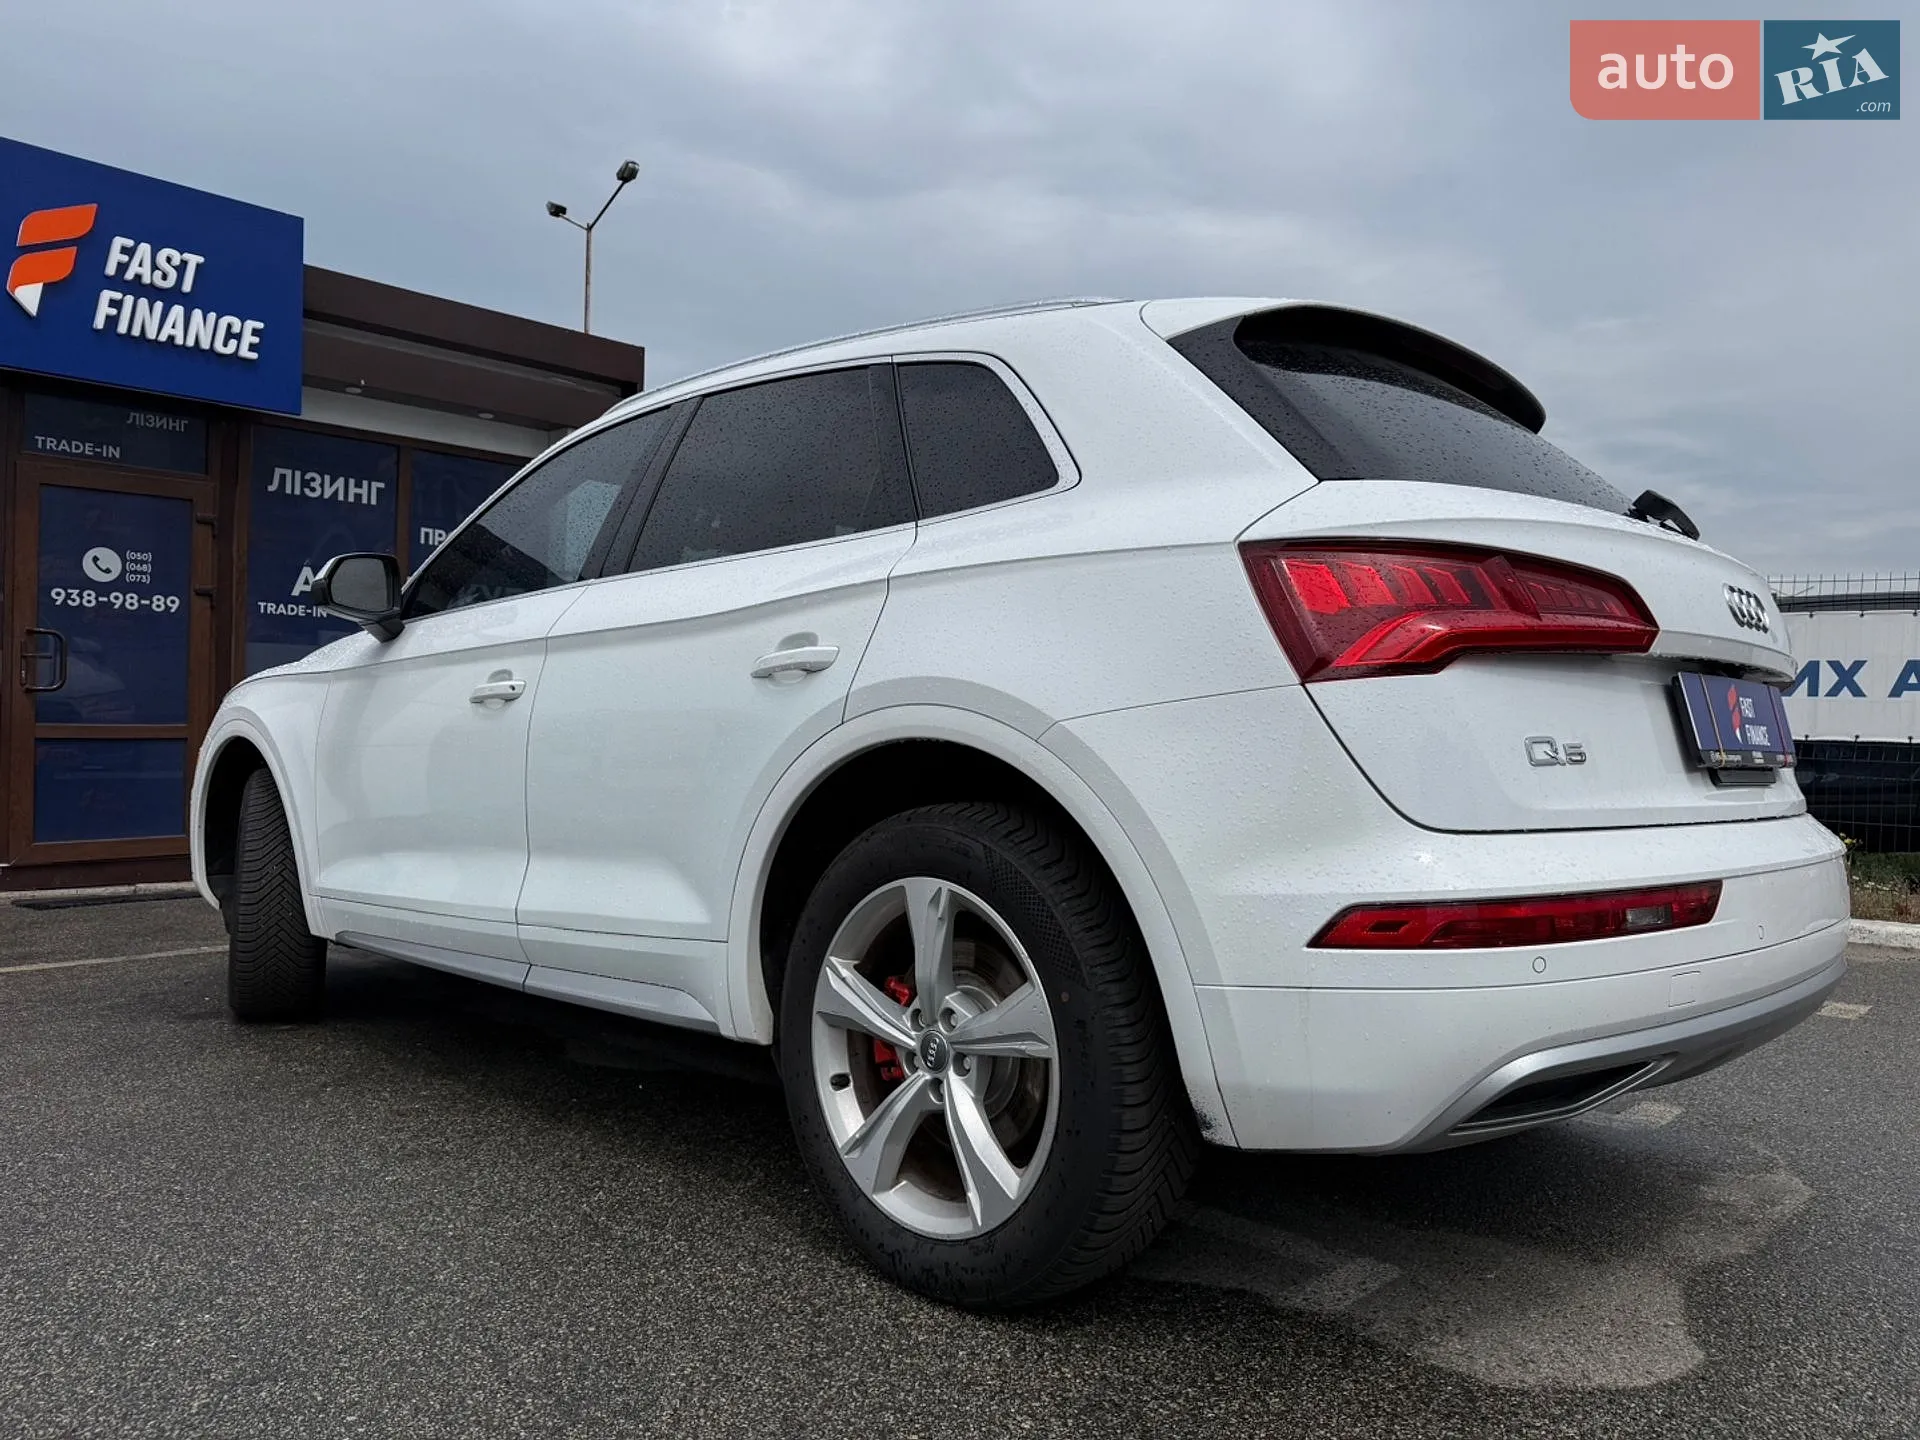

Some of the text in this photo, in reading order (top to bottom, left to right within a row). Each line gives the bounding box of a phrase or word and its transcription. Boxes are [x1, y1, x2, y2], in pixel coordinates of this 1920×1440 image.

[104, 236, 205, 293] FAST
[93, 289, 265, 360] FINANCE
[126, 411, 189, 433] ЛІЗИНГ
[34, 435, 121, 459] TRADE-IN
[267, 467, 386, 506] ЛІЗИНГ
[420, 527, 452, 546] ПР
[125, 573, 151, 584] (073)
[50, 588, 181, 613] 938-98-89
[257, 602, 328, 618] TRADE-IN
[1739, 697, 1756, 718] FAST
[1745, 724, 1771, 746] FINANCE
[1523, 735, 1587, 767] Q5
